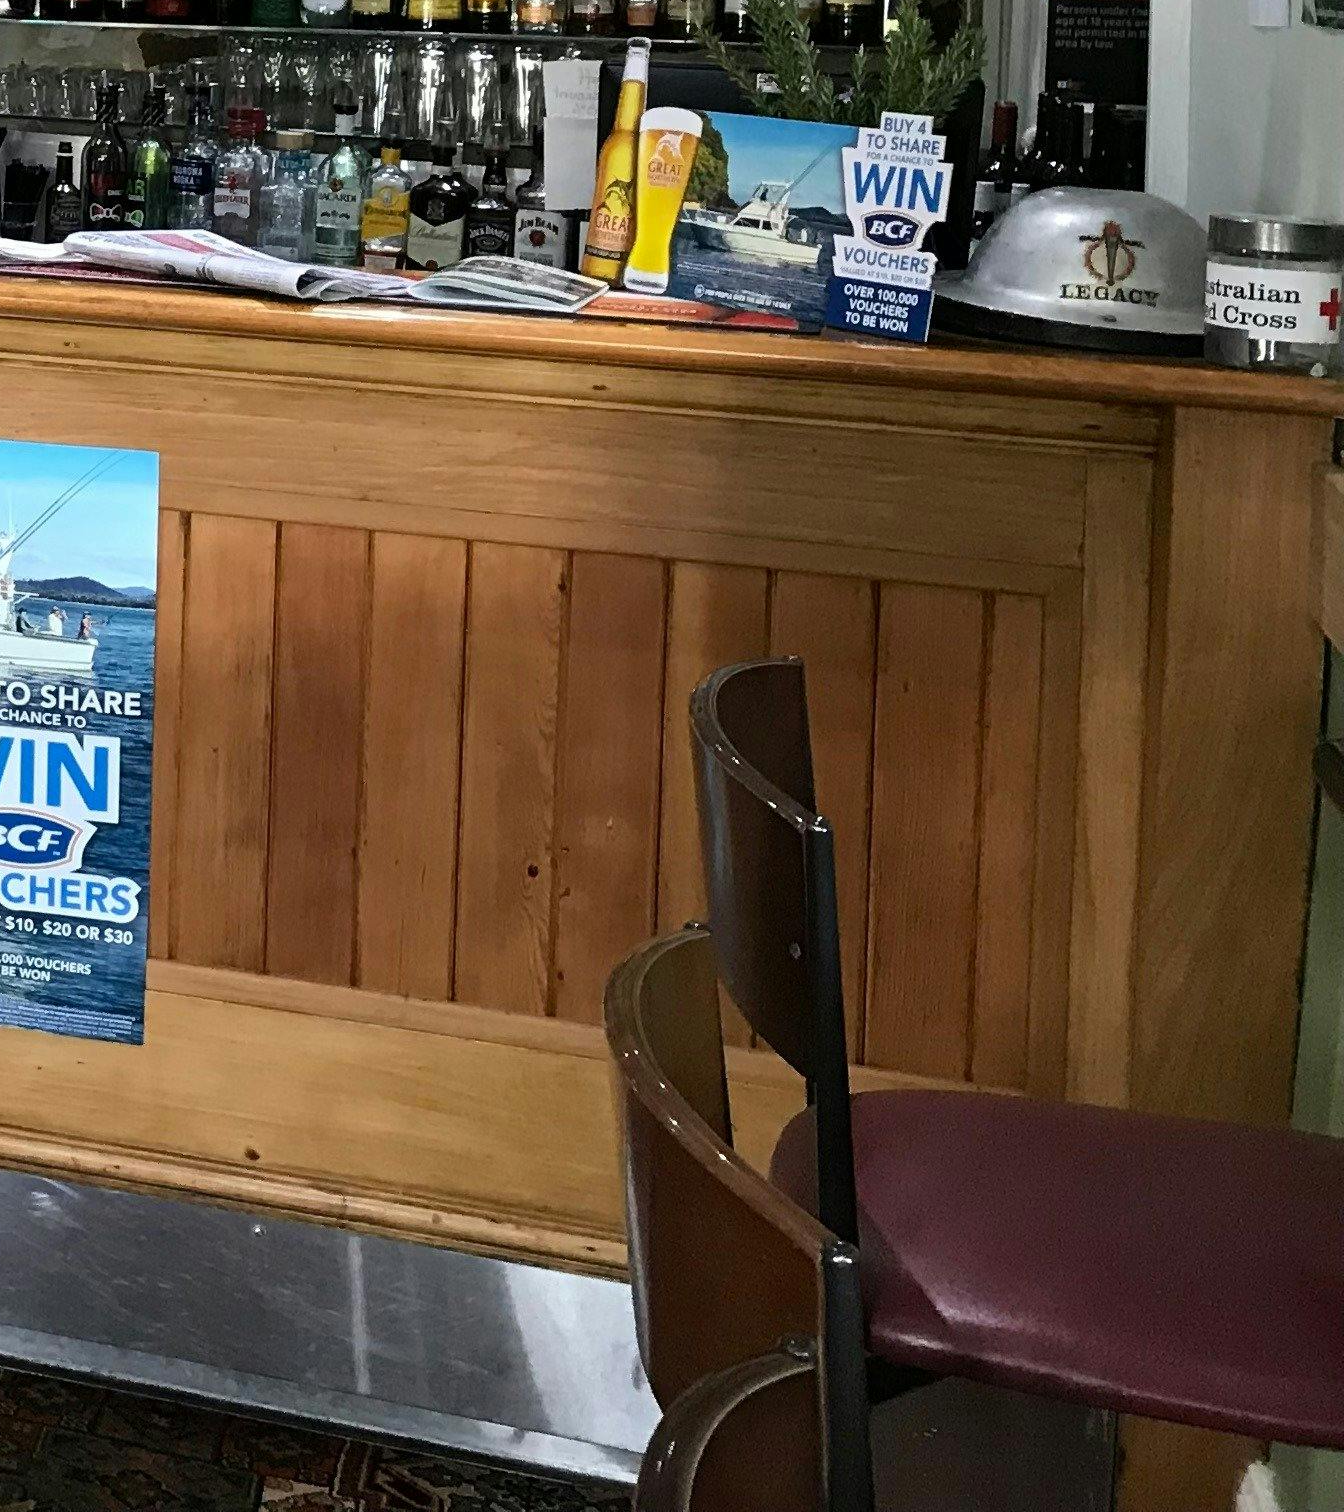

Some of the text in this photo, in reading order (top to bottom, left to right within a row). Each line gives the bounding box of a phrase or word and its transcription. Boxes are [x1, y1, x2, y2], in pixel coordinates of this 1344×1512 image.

[883, 117, 927, 134] BUY 4
[867, 134, 940, 155] TO SHARE
[853, 161, 944, 213] WIN
[869, 220, 912, 238] BCF
[843, 247, 929, 274] VOUCHERS
[844, 284, 919, 306] OVER 100,000
[1060, 283, 1160, 307] LEGACY
[849, 298, 909, 319] VOUCHERS
[1223, 305, 1297, 329] Cross
[845, 310, 909, 333] TO BE WON
[40, 685, 141, 716] SHARE
[64, 715, 86, 729] TO
[5, 915, 39, 935] $10,
[42, 920, 72, 938] $20
[76, 925, 100, 941] OR
[104, 928, 133, 945] $30
[1, 965, 16, 978] BE
[19, 967, 51, 982] WON
[25, 956, 92, 975] VOUCHERS
